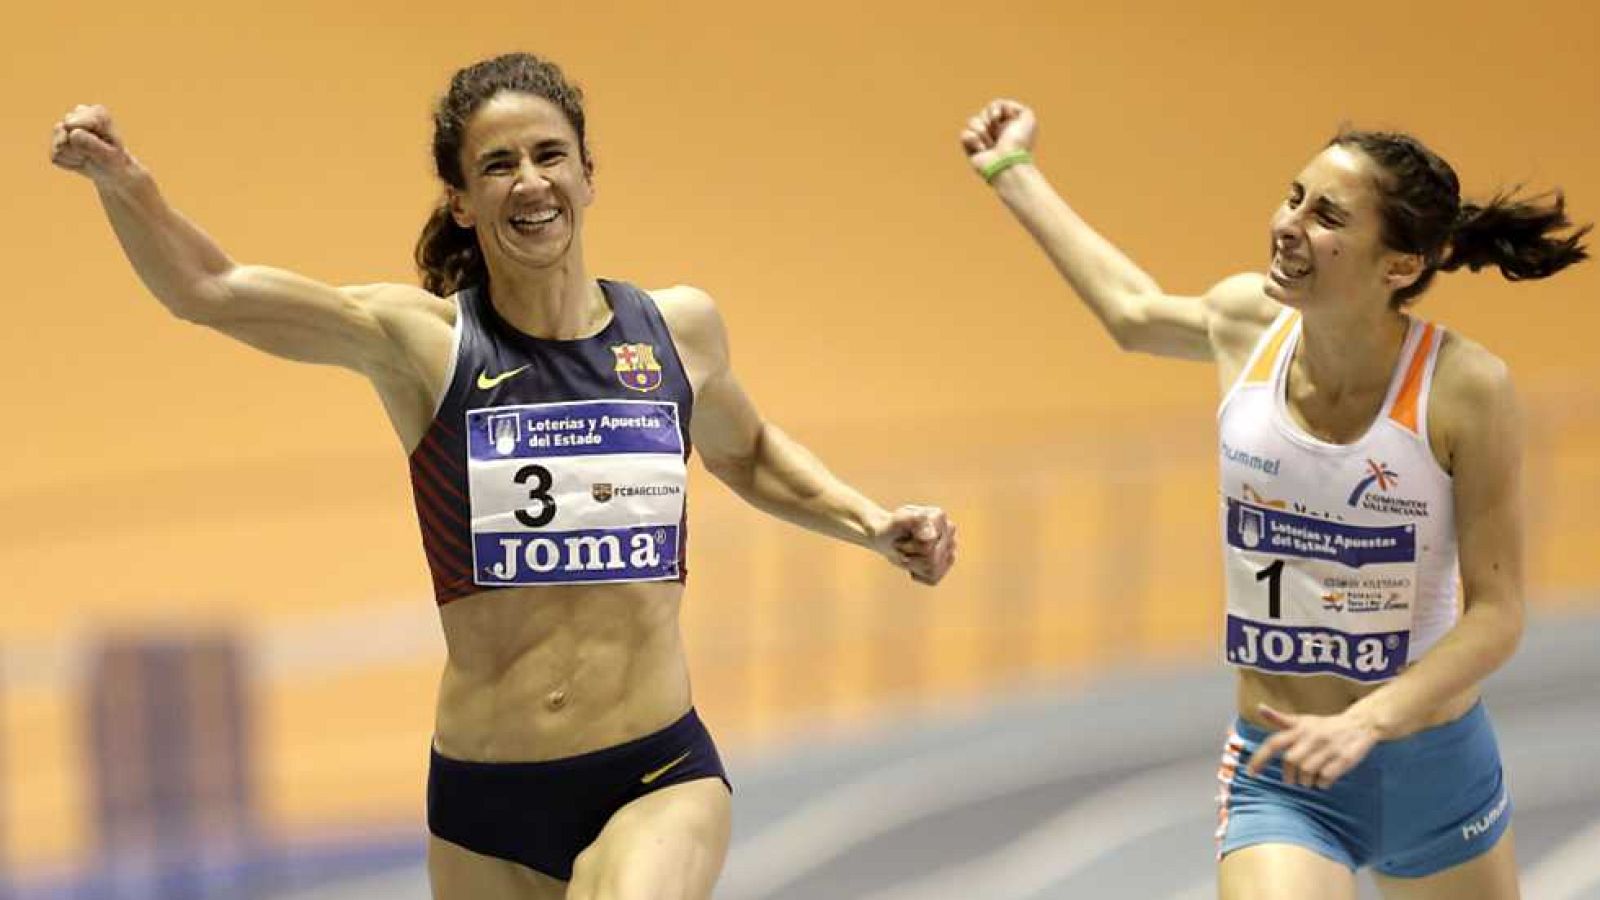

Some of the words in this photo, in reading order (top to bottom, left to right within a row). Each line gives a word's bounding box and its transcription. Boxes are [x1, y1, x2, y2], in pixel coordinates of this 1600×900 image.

[528, 435, 551, 447] del
[554, 433, 602, 447] Estado
[588, 418, 597, 437] y
[601, 414, 661, 430] Apuestas
[514, 464, 557, 527] 3
[1256, 559, 1285, 619] 1
